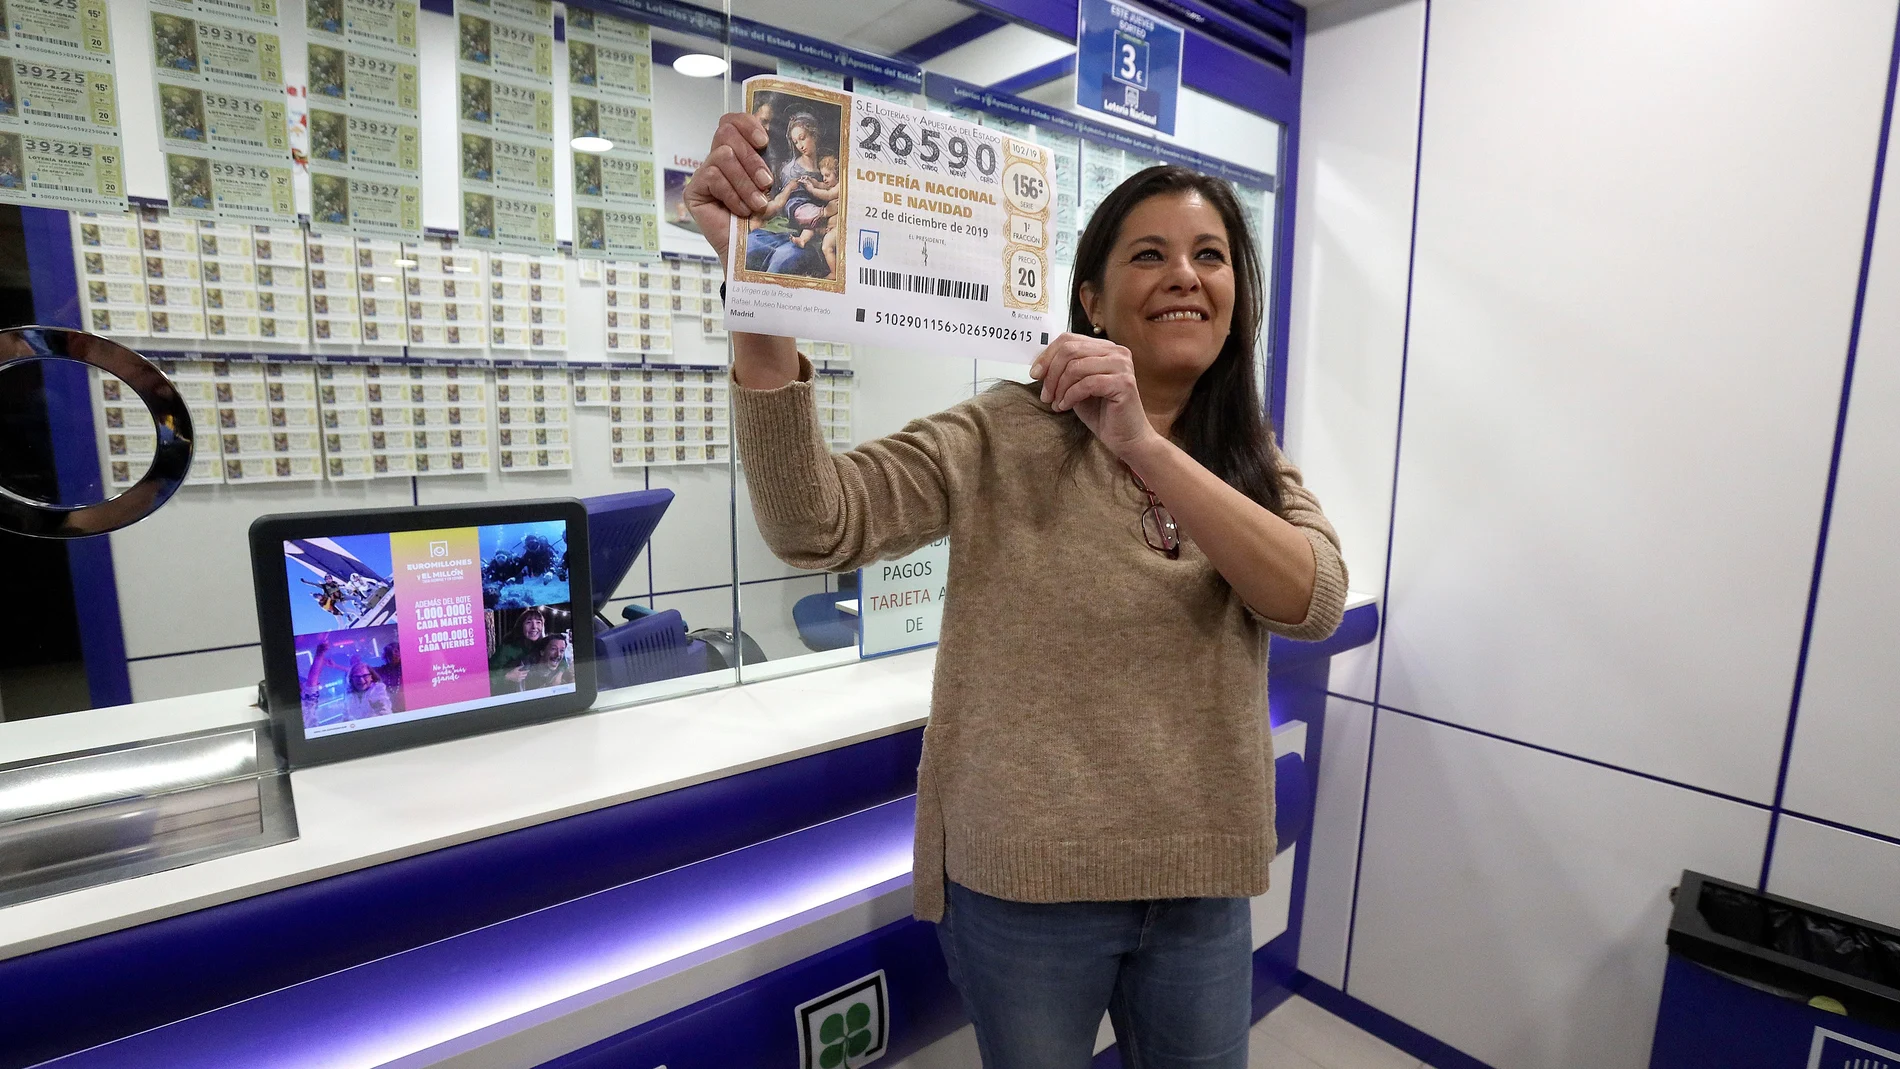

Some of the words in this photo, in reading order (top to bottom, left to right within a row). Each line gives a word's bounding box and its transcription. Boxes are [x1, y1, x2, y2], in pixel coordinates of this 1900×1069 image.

[1111, 4, 1129, 20] ESTE
[199, 25, 257, 45] 59316
[494, 25, 535, 44] 33578
[91, 38, 102, 47] 20
[598, 48, 634, 62] 52999
[751, 31, 765, 41] del
[767, 34, 796, 50] Estado
[848, 57, 882, 73] Apuestas
[884, 67, 896, 77] del
[347, 55, 396, 75] 33927
[16, 63, 85, 84] 39225
[494, 84, 535, 100] 33578
[206, 94, 263, 113] 59316
[600, 104, 637, 118] 52999
[1129, 107, 1157, 125] Nacional
[349, 120, 398, 136] 33927
[25, 139, 92, 157] 39225
[495, 142, 536, 157] 33578
[859, 116, 996, 176] 26590
[1012, 143, 1037, 158] 102/19
[603, 158, 639, 172] 52999
[674, 154, 703, 168] Lote
[213, 163, 269, 179] 59316
[949, 169, 967, 178] NUEVE
[105, 183, 116, 191] 20
[351, 182, 399, 196] 33927
[856, 168, 920, 191] LOTERÍA
[925, 181, 997, 206] NACIONAL
[496, 199, 537, 214] 33578
[883, 191, 902, 206] DE
[907, 196, 973, 218] NAVIDAD
[1020, 201, 1034, 210] SERIE
[606, 212, 642, 224] 52999
[865, 206, 878, 218] 22
[881, 209, 894, 221] de
[897, 213, 947, 230] diciembre
[950, 222, 963, 234] de
[965, 225, 988, 238] 2019
[1013, 232, 1040, 244] FRACCIÓN
[1018, 255, 1036, 265] PRECIO
[1018, 267, 1036, 287] 20
[732, 285, 740, 293] La
[741, 286, 761, 296] Virgen
[771, 288, 777, 296] la
[778, 290, 793, 299] Rosa
[1018, 290, 1036, 299] EUROS
[753, 300, 776, 308] Museo
[776, 302, 803, 311] Nacional
[875, 311, 1032, 342] 5102901156>0265902615
[407, 558, 473, 571] EUROMILLONES
[883, 561, 932, 581] PAGOS
[421, 572, 431, 580] EL
[432, 568, 464, 578] MILLÓN
[414, 598, 441, 609] ADEMÁS
[443, 597, 455, 605] DEL
[455, 595, 472, 604] BOTE
[870, 589, 931, 611] TARJETA
[415, 603, 472, 620] 1.000.000€
[416, 619, 438, 630] CADA
[440, 615, 473, 627] MARTES
[906, 617, 923, 633] DE
[424, 628, 474, 643] 1.000.000€
[418, 642, 440, 653] CADA
[441, 638, 475, 650] VIERNES
[431, 673, 460, 687] grande
